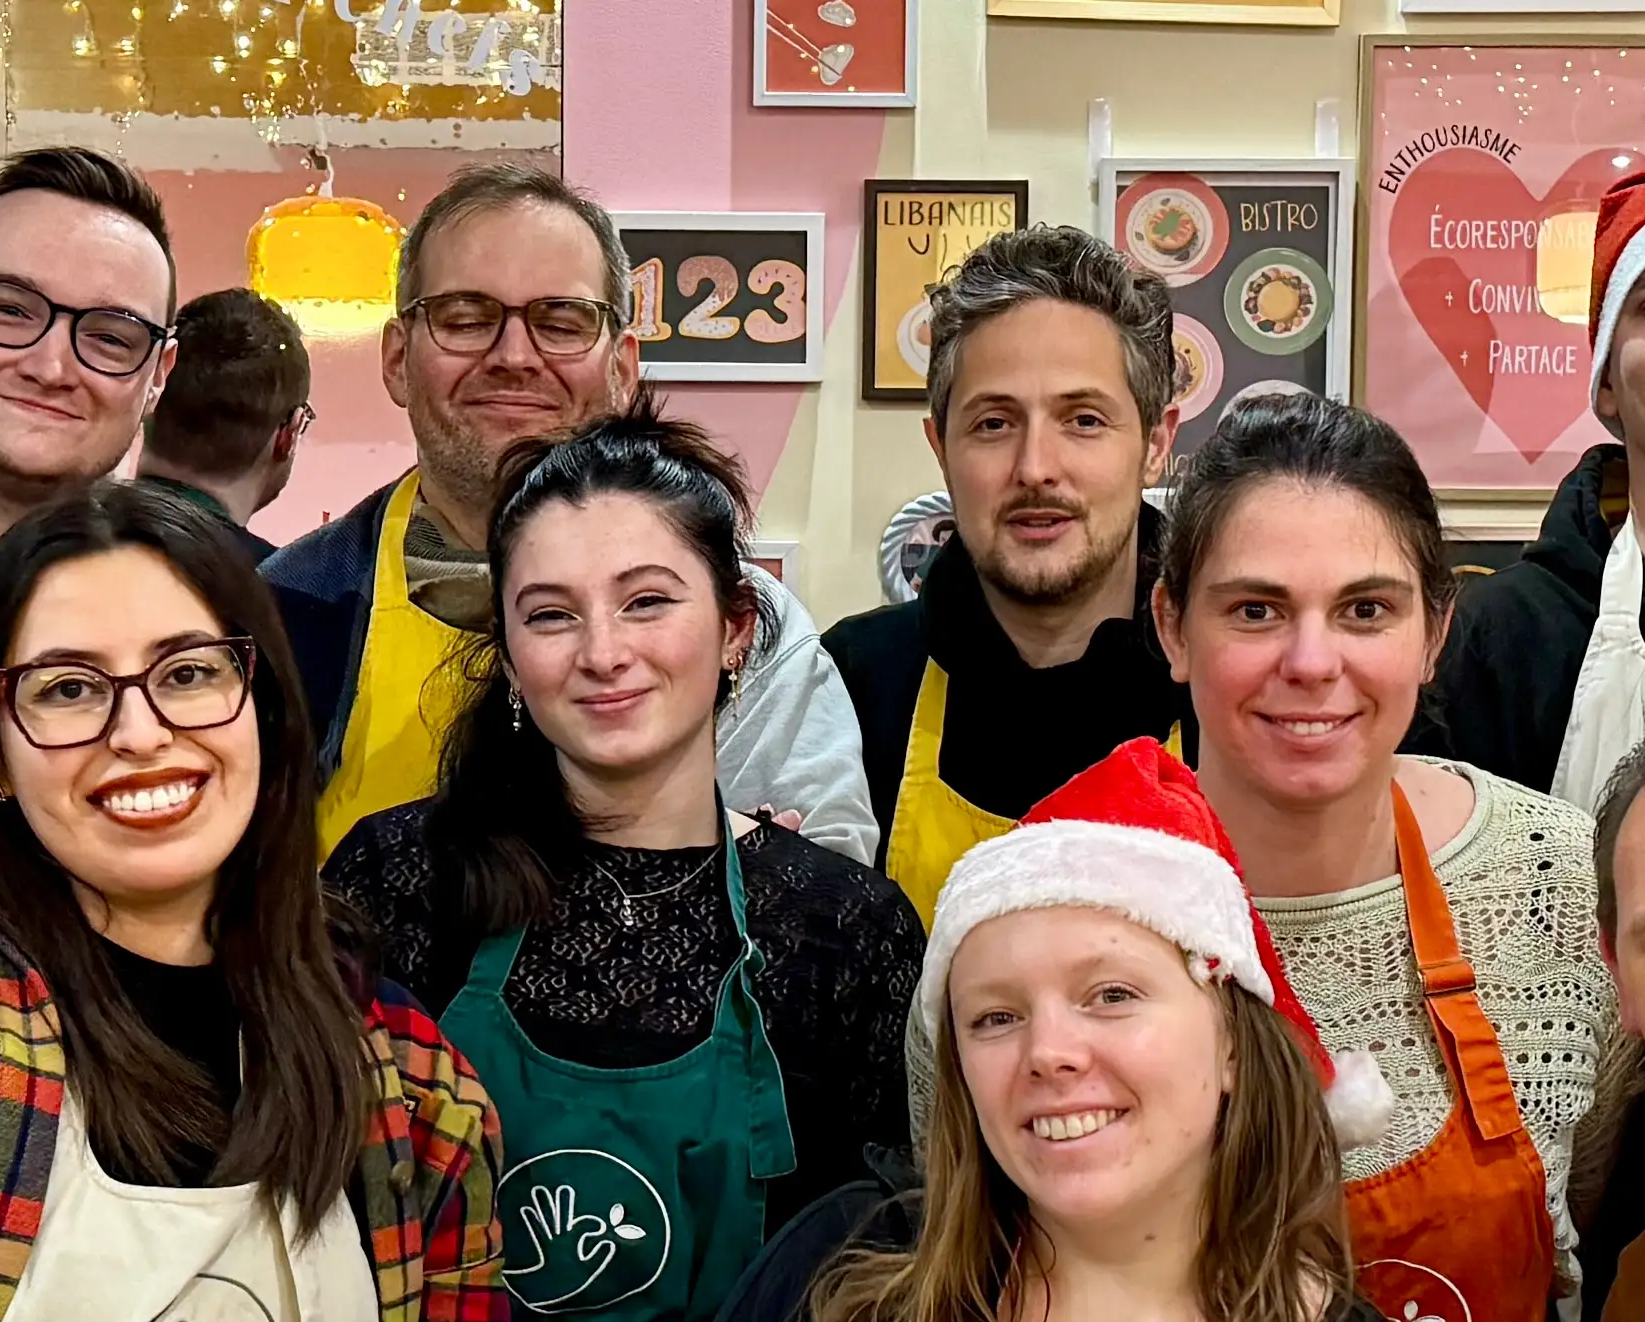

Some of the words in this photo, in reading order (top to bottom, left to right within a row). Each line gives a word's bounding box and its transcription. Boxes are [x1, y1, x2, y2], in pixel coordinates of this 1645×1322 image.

[1378, 124, 1522, 194] ENTHOUSIASME
[884, 200, 1012, 227] LIBANAIS
[1240, 200, 1318, 232] BISTRO
[1430, 204, 1597, 250] ÉCORESPONSAB
[629, 255, 806, 343] 123
[1489, 340, 1577, 377] PARTAGE
